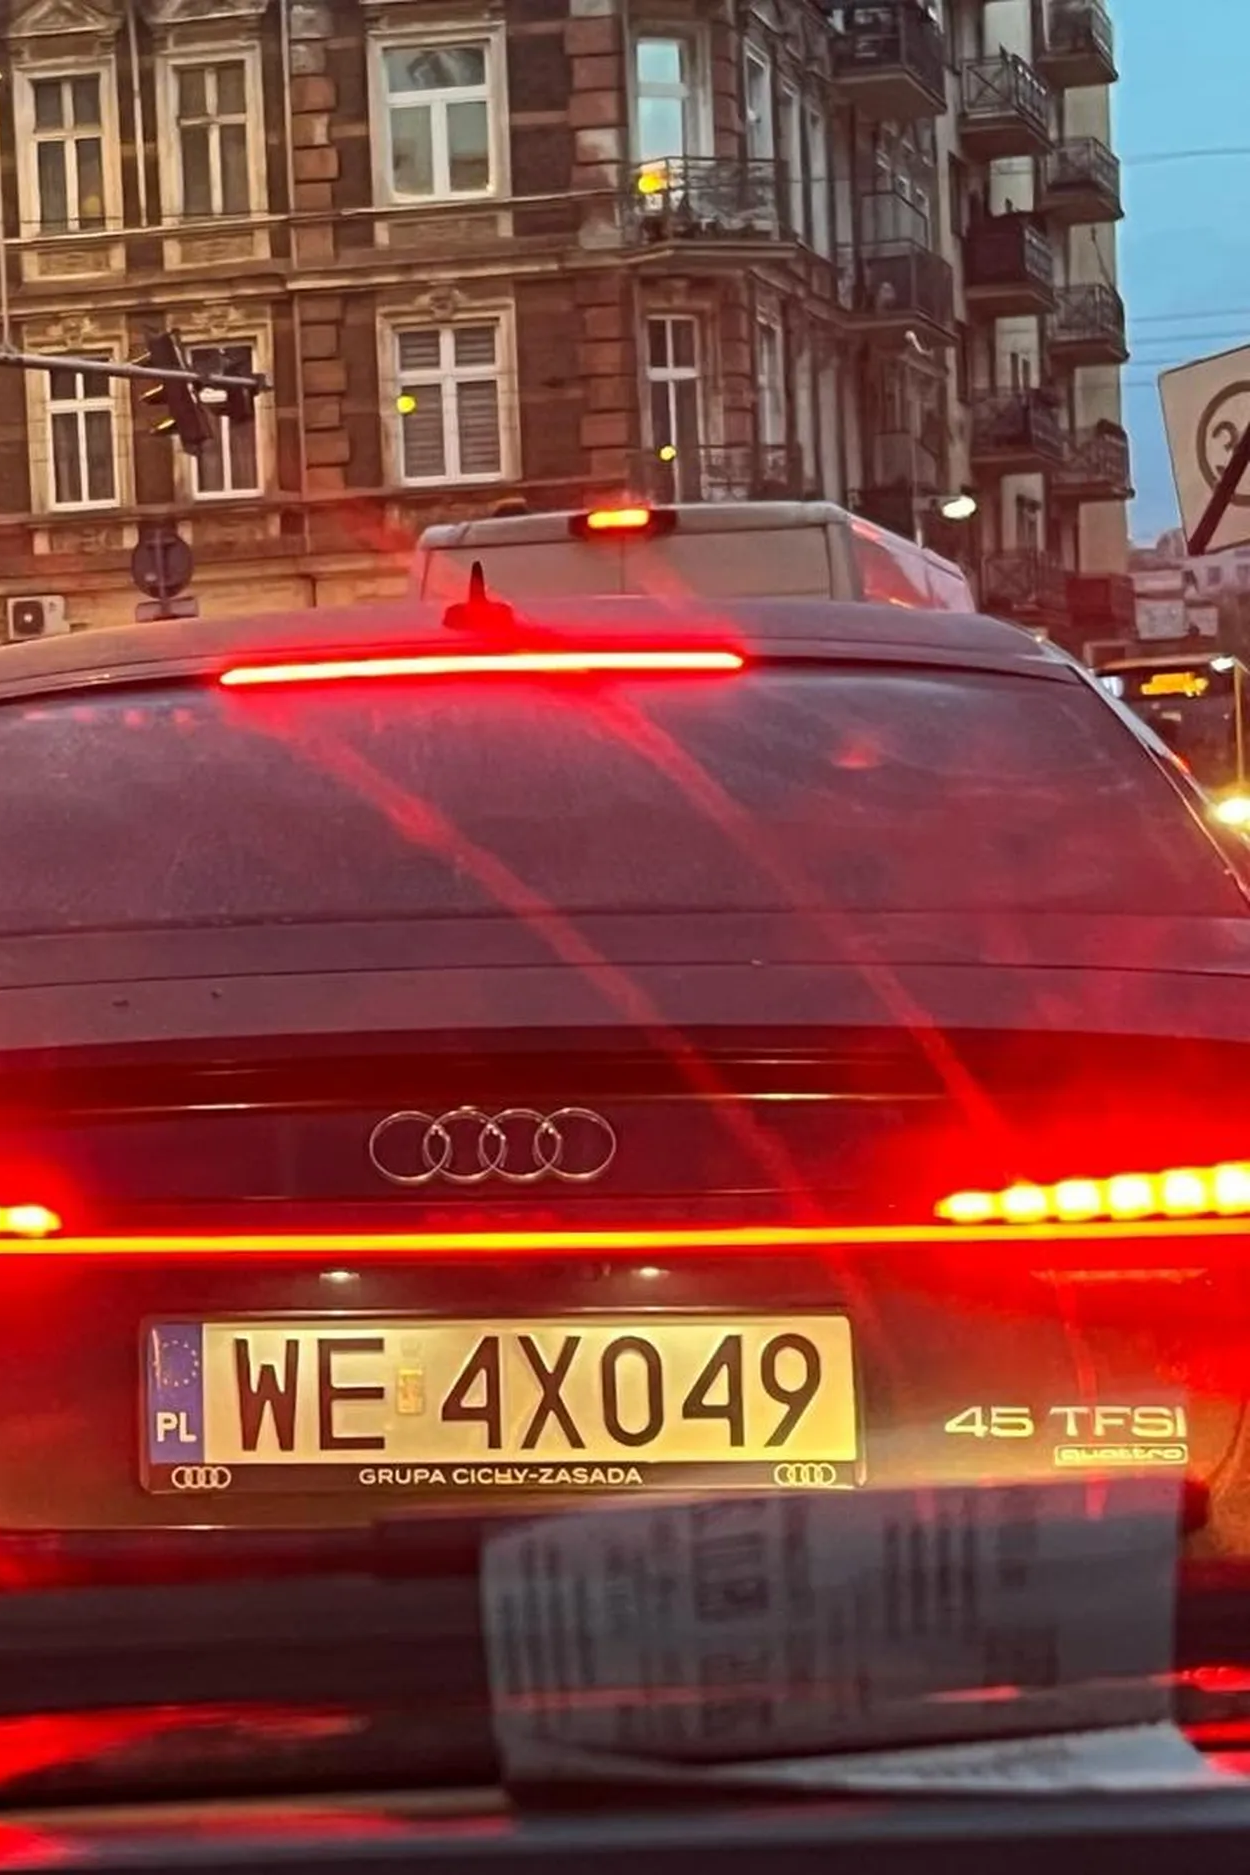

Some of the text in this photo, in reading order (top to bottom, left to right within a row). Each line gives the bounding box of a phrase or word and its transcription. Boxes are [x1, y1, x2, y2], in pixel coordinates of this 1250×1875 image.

[233, 1332, 821, 1452] WE 4X049
[155, 1411, 197, 1443] PL
[944, 1405, 1188, 1438] 45 TFSI
[1058, 1446, 1184, 1464] quattro
[358, 1466, 644, 1485] GRUPA CICHY-ZASADA
